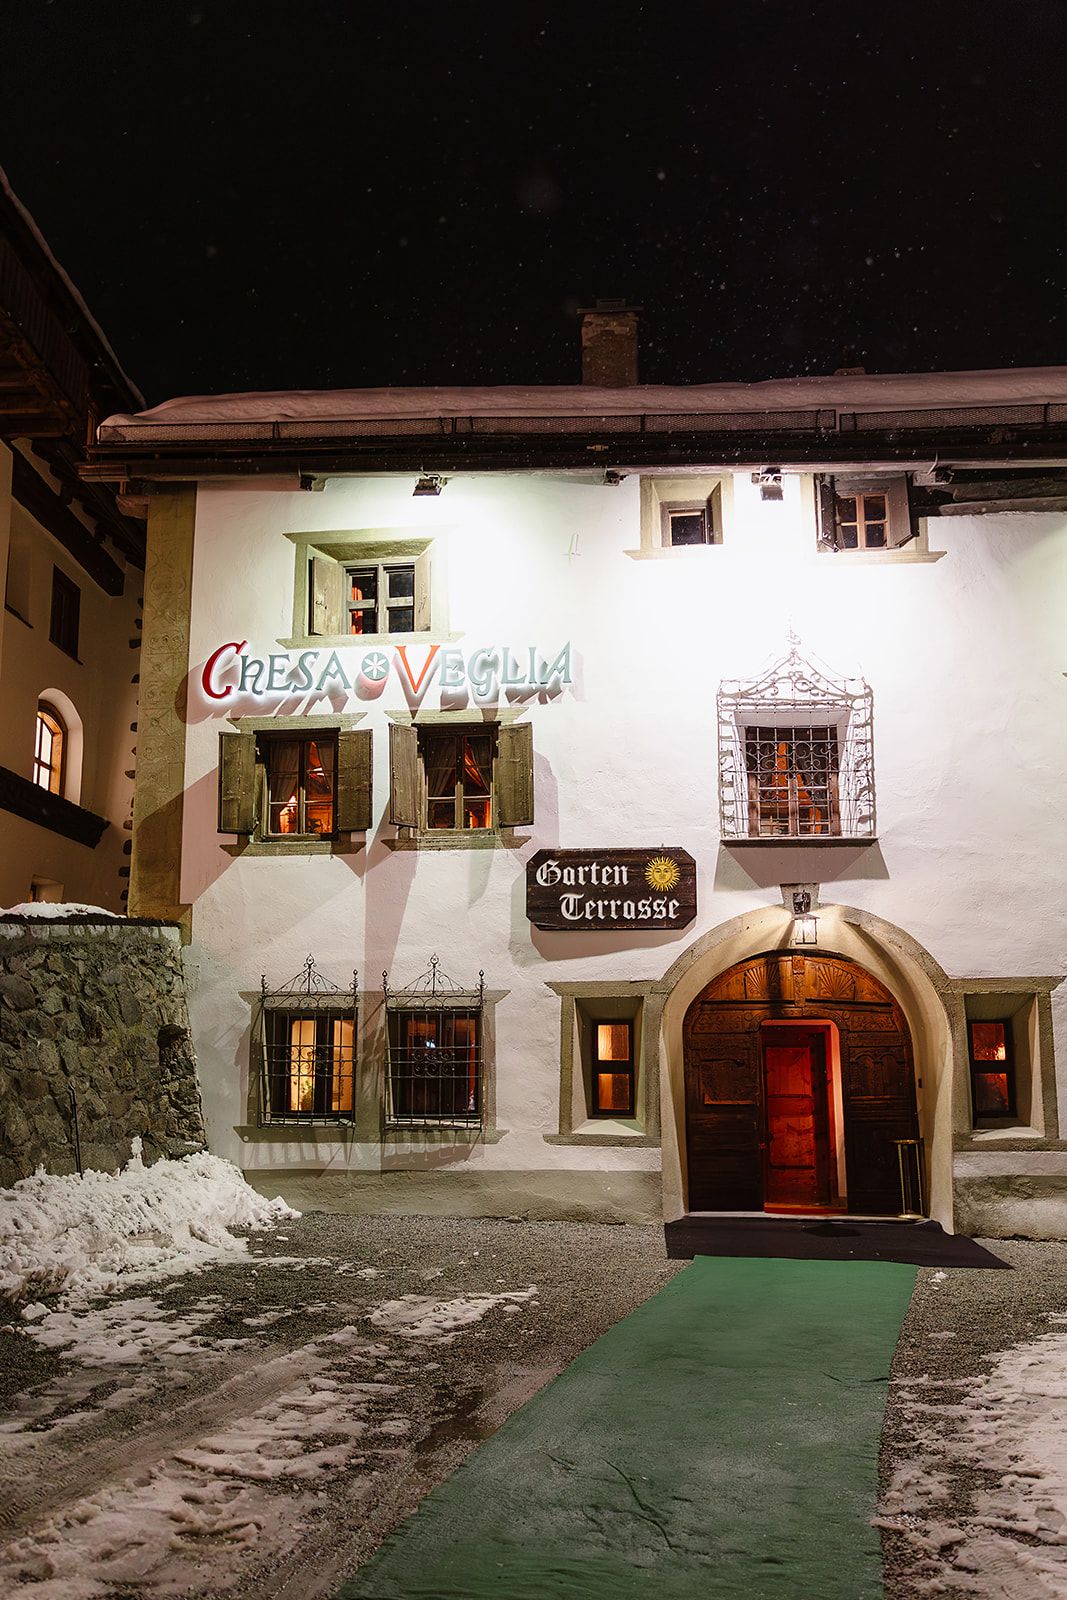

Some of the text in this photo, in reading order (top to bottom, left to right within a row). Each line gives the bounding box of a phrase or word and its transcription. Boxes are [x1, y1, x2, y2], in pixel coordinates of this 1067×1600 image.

[396, 641, 572, 696] VEGLIA
[535, 859, 629, 887] Garten
[559, 893, 681, 921] Terrasse
